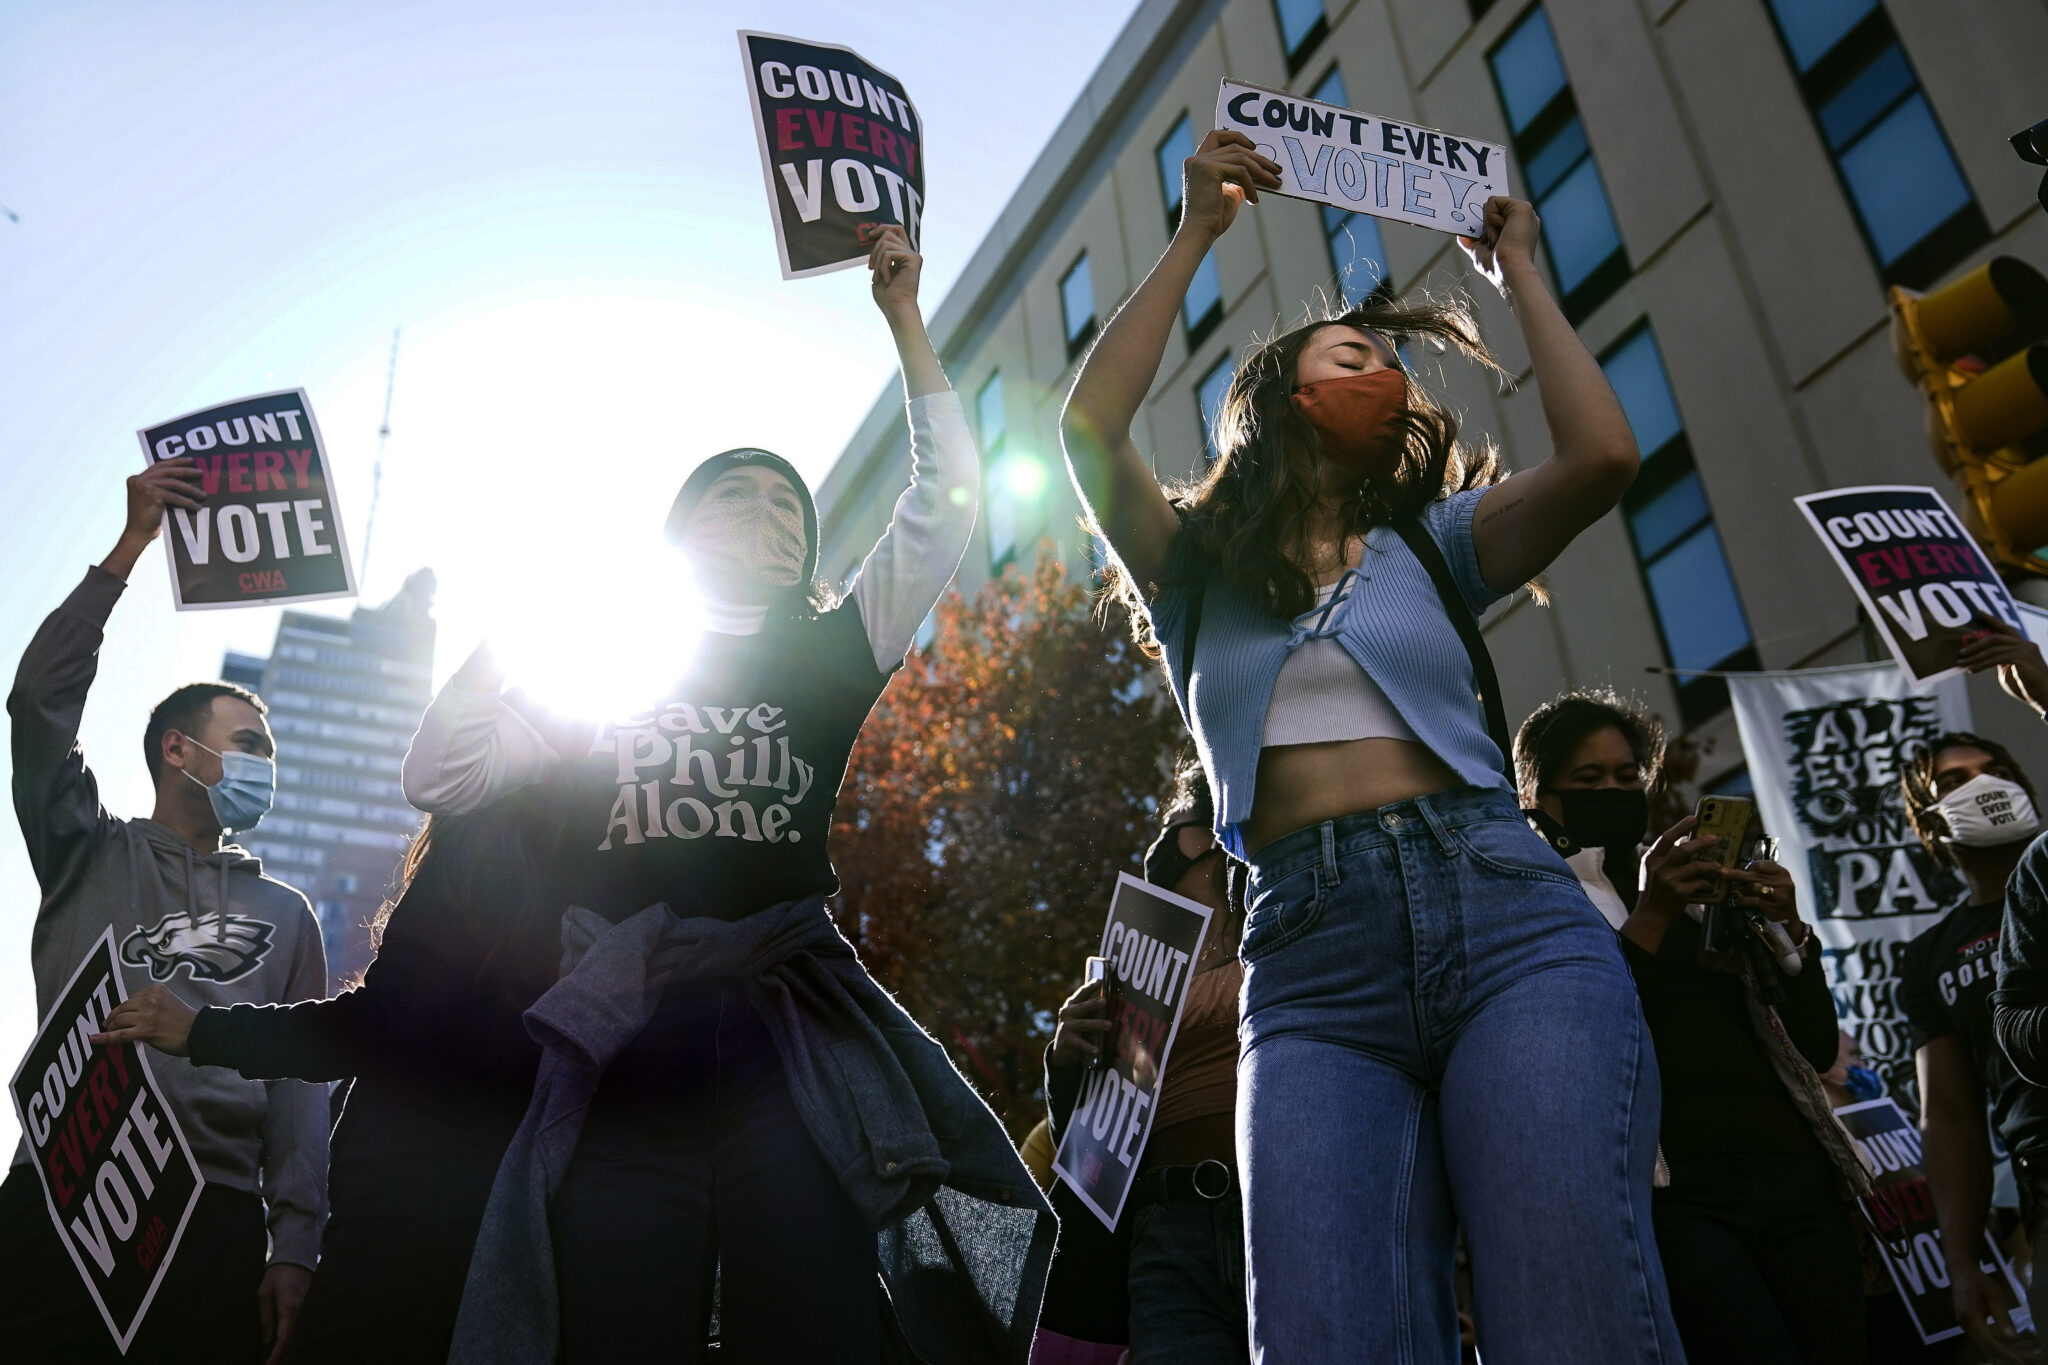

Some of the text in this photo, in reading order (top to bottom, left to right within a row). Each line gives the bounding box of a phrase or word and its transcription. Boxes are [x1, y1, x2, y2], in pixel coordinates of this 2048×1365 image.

[760, 60, 911, 132] COUNT
[776, 107, 917, 178] EVERY
[1227, 92, 1491, 177] COUNT EVERY
[779, 158, 922, 253] VOTE
[1282, 135, 1478, 223] VOTE!
[155, 409, 303, 461] COUNT
[193, 448, 313, 495] VERY
[173, 499, 333, 565] VOTE
[1826, 509, 1960, 549] COUNT
[238, 569, 288, 593] CWA
[1856, 544, 1984, 588] EVERY
[1877, 581, 2022, 642] VOTE
[615, 727, 814, 805] Philly
[1975, 790, 2008, 805] COUNT
[598, 779, 801, 851] Alone.
[1850, 813, 1905, 845] ON
[1981, 801, 2012, 816] EVERY
[1988, 812, 2017, 826] VOTE
[1831, 848, 1939, 917] PA
[1107, 921, 1189, 1006] COUNT
[1964, 937, 1995, 957] NOT
[28, 971, 111, 1148] COUNT
[1106, 995, 1168, 1076] VERY
[48, 1043, 130, 1208] EVERY
[1080, 1067, 1150, 1168] VOTE
[70, 1086, 174, 1279] VOTE
[137, 1213, 168, 1270] CWA
